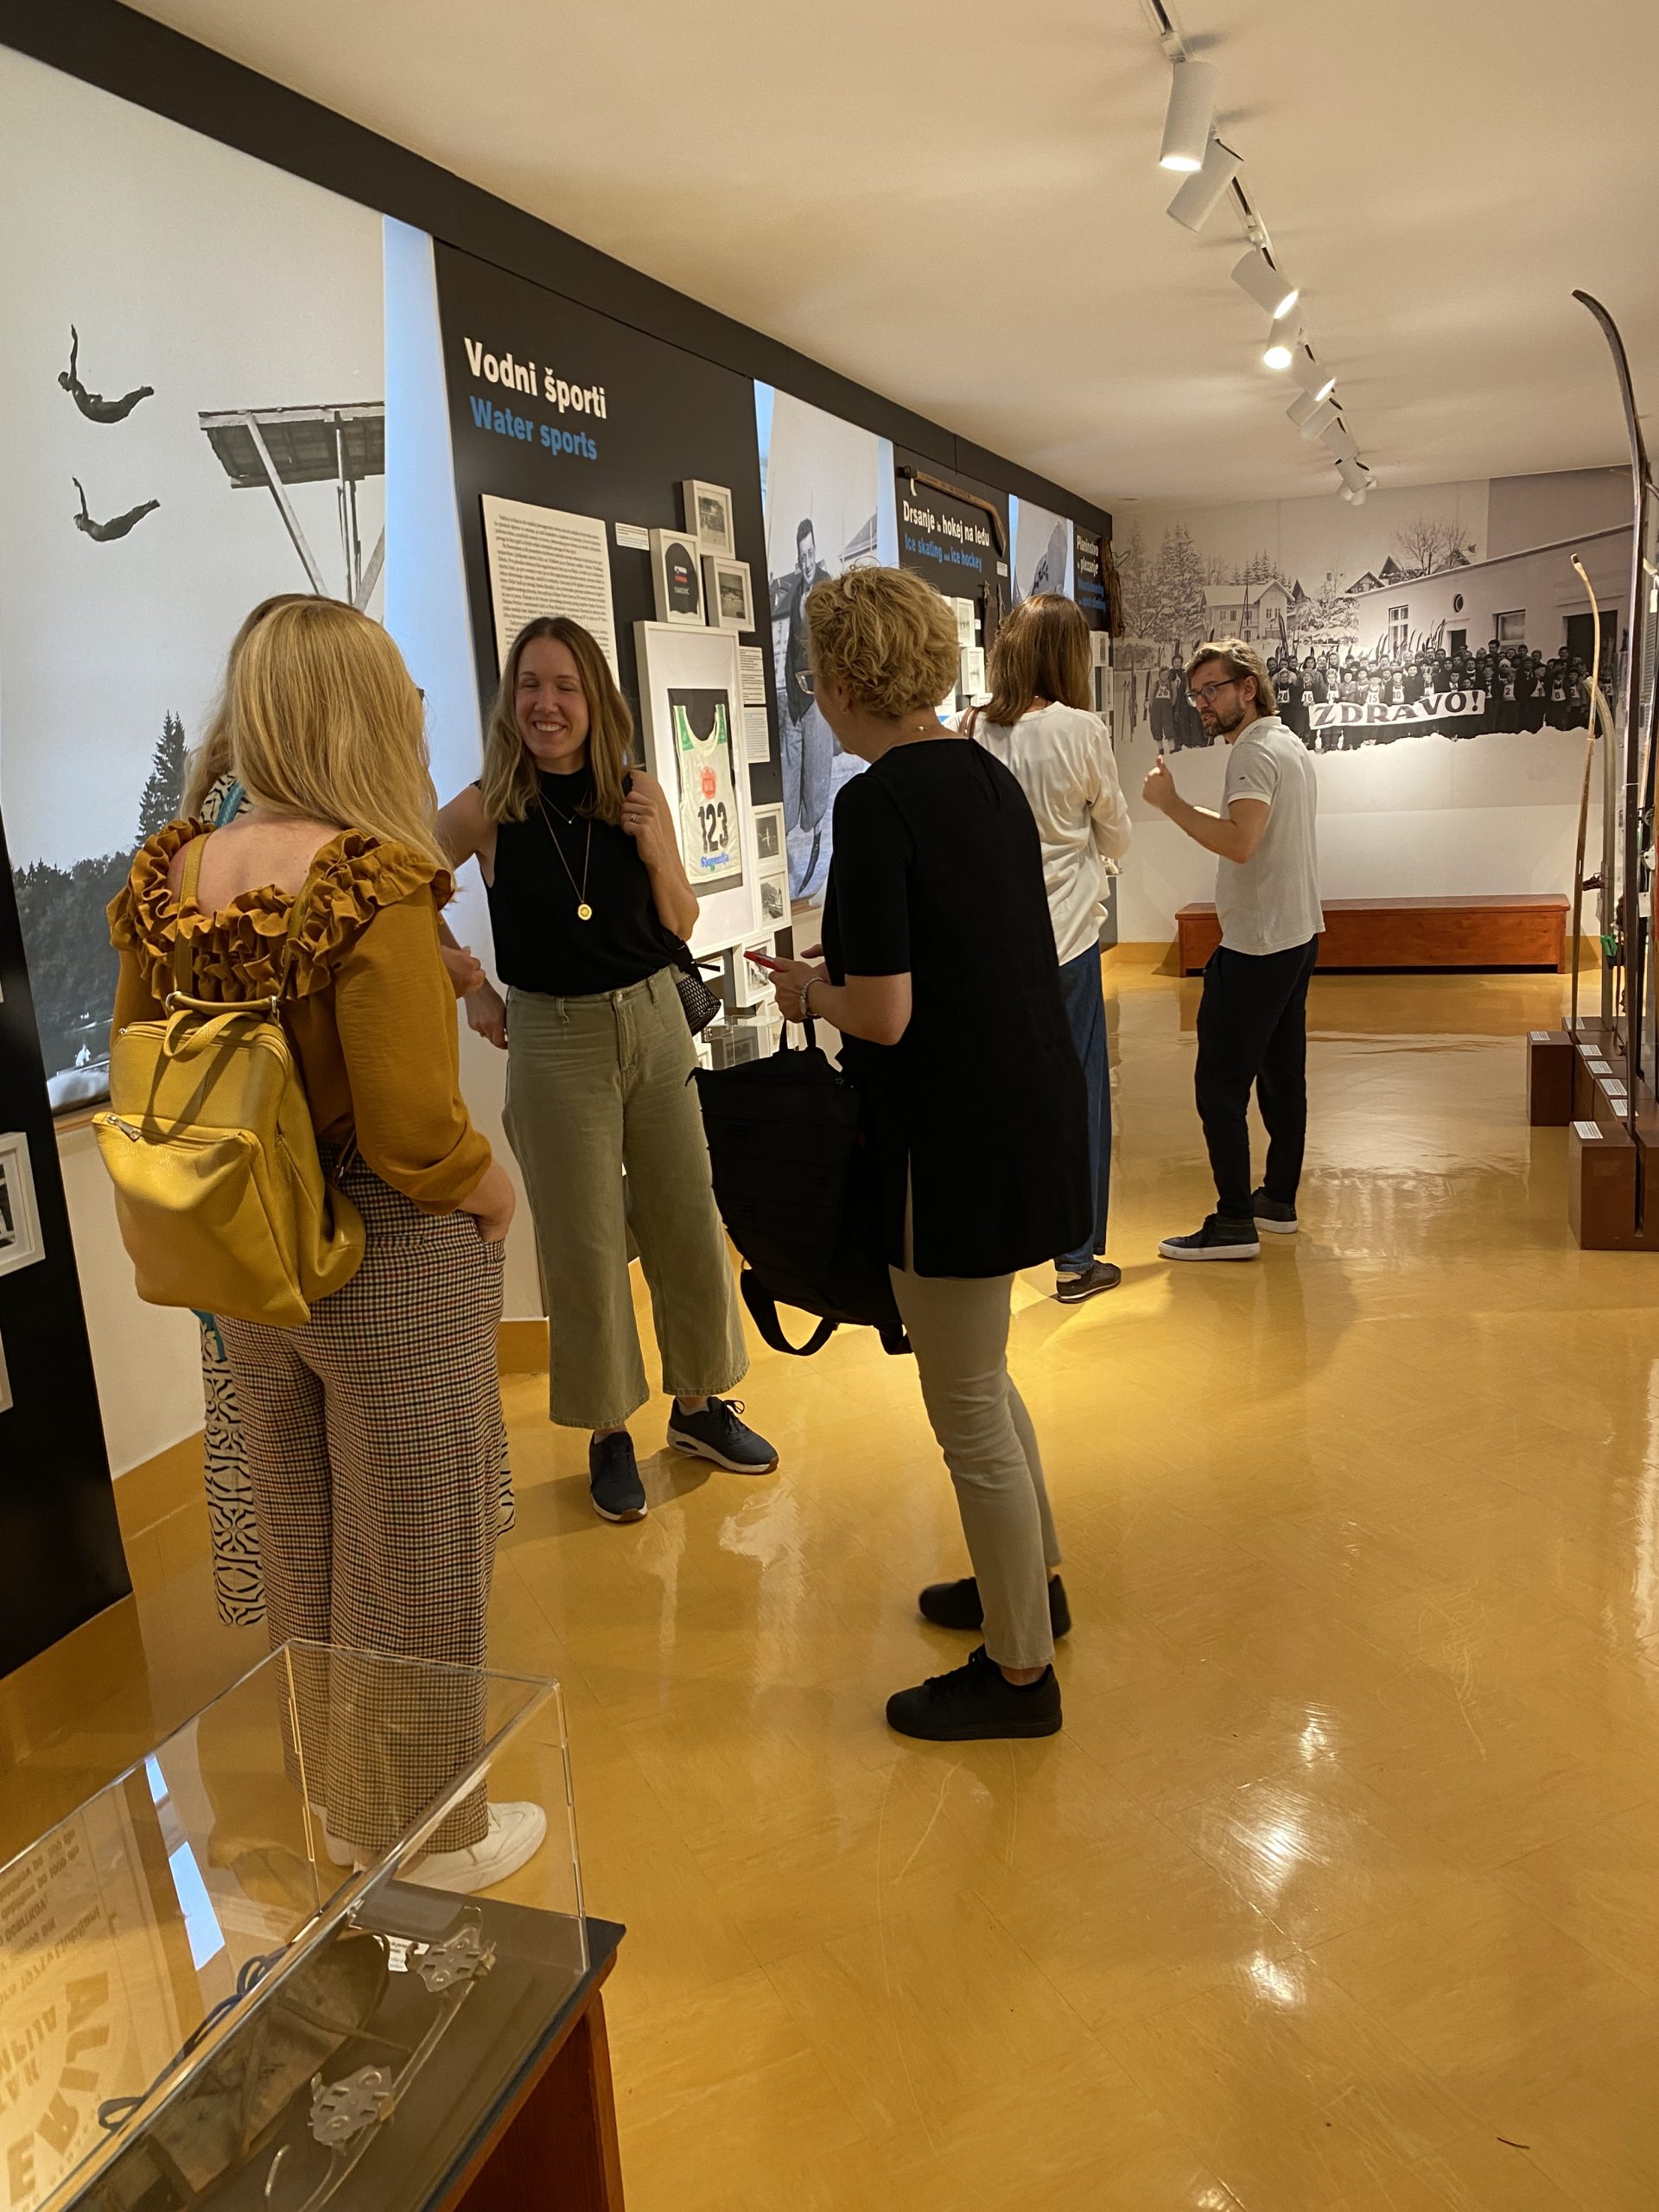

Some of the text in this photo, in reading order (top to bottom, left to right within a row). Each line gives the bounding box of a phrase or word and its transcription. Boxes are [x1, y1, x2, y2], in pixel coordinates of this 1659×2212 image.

[464, 337, 607, 419] Vodni športi
[470, 396, 598, 461] Water sports
[903, 499, 935, 533] Drsanje
[942, 514, 963, 543] hokej
[964, 525, 974, 543] na
[975, 524, 990, 546] ledu
[905, 532, 916, 552] Ice
[918, 537, 943, 563] skating
[962, 548, 982, 573] hockey
[1158, 688, 1168, 696] 26
[1278, 692, 1288, 702] 28
[1313, 690, 1479, 727] ZDRAVO!
[1369, 694, 1377, 702] 15
[1505, 687, 1511, 696] 2
[698, 801, 729, 854] 123
